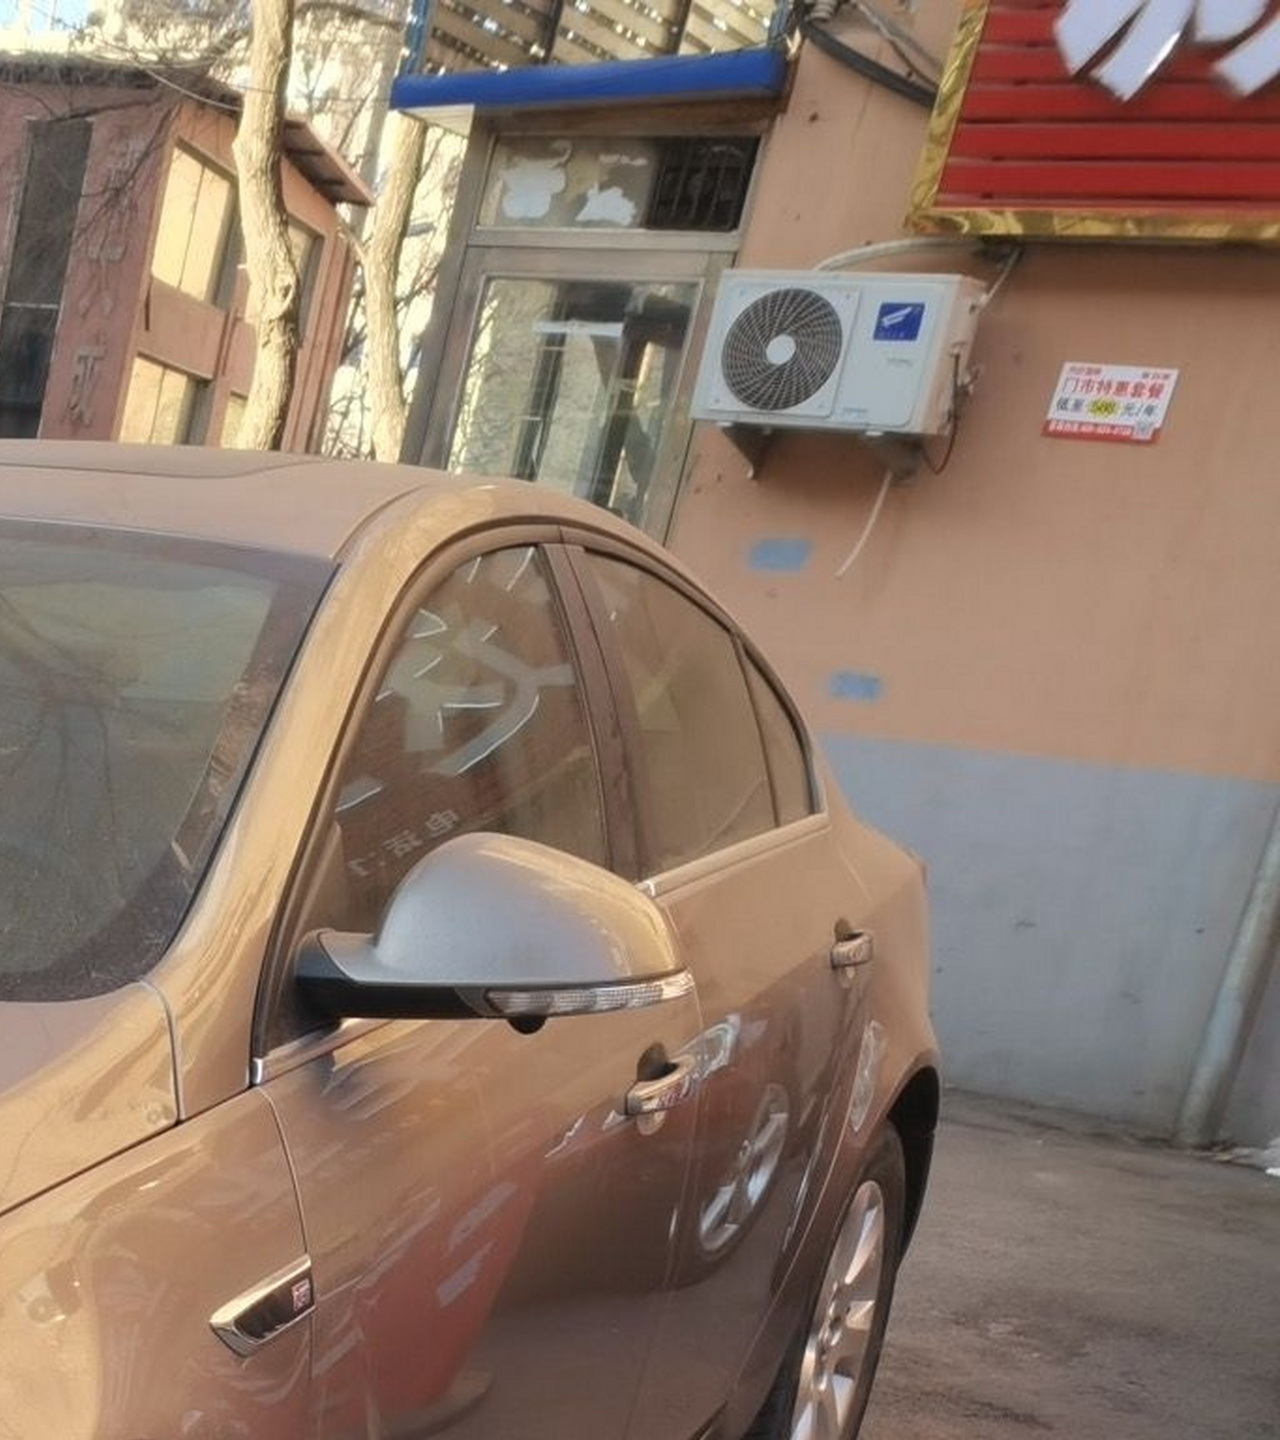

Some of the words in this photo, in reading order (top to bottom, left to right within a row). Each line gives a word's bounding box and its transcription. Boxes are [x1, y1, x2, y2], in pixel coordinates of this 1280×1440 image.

[1061, 376, 1166, 399] 门市特惠套餐
